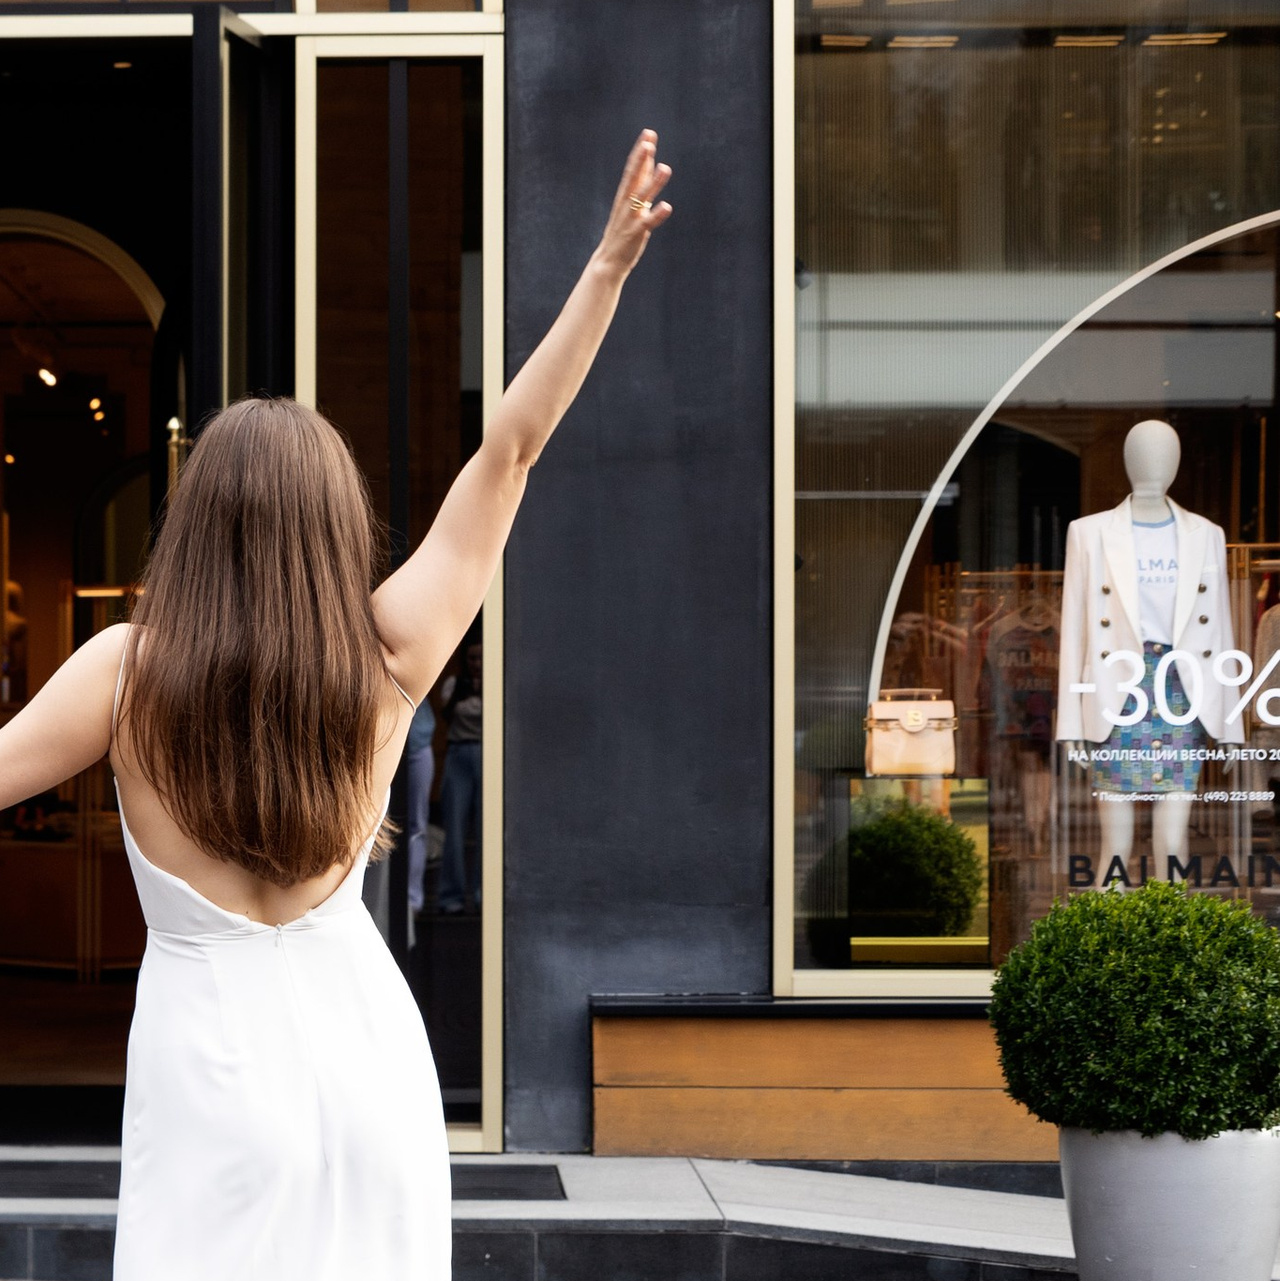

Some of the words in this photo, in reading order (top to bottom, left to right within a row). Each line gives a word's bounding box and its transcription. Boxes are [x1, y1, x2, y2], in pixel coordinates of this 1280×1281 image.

[1069, 649, 1280, 726] -30%
[1068, 749, 1089, 761] НА
[1091, 749, 1178, 762] КОЛЛЕКЦИИ
[1180, 748, 1267, 761] ВЕСНА-ЛЕТО
